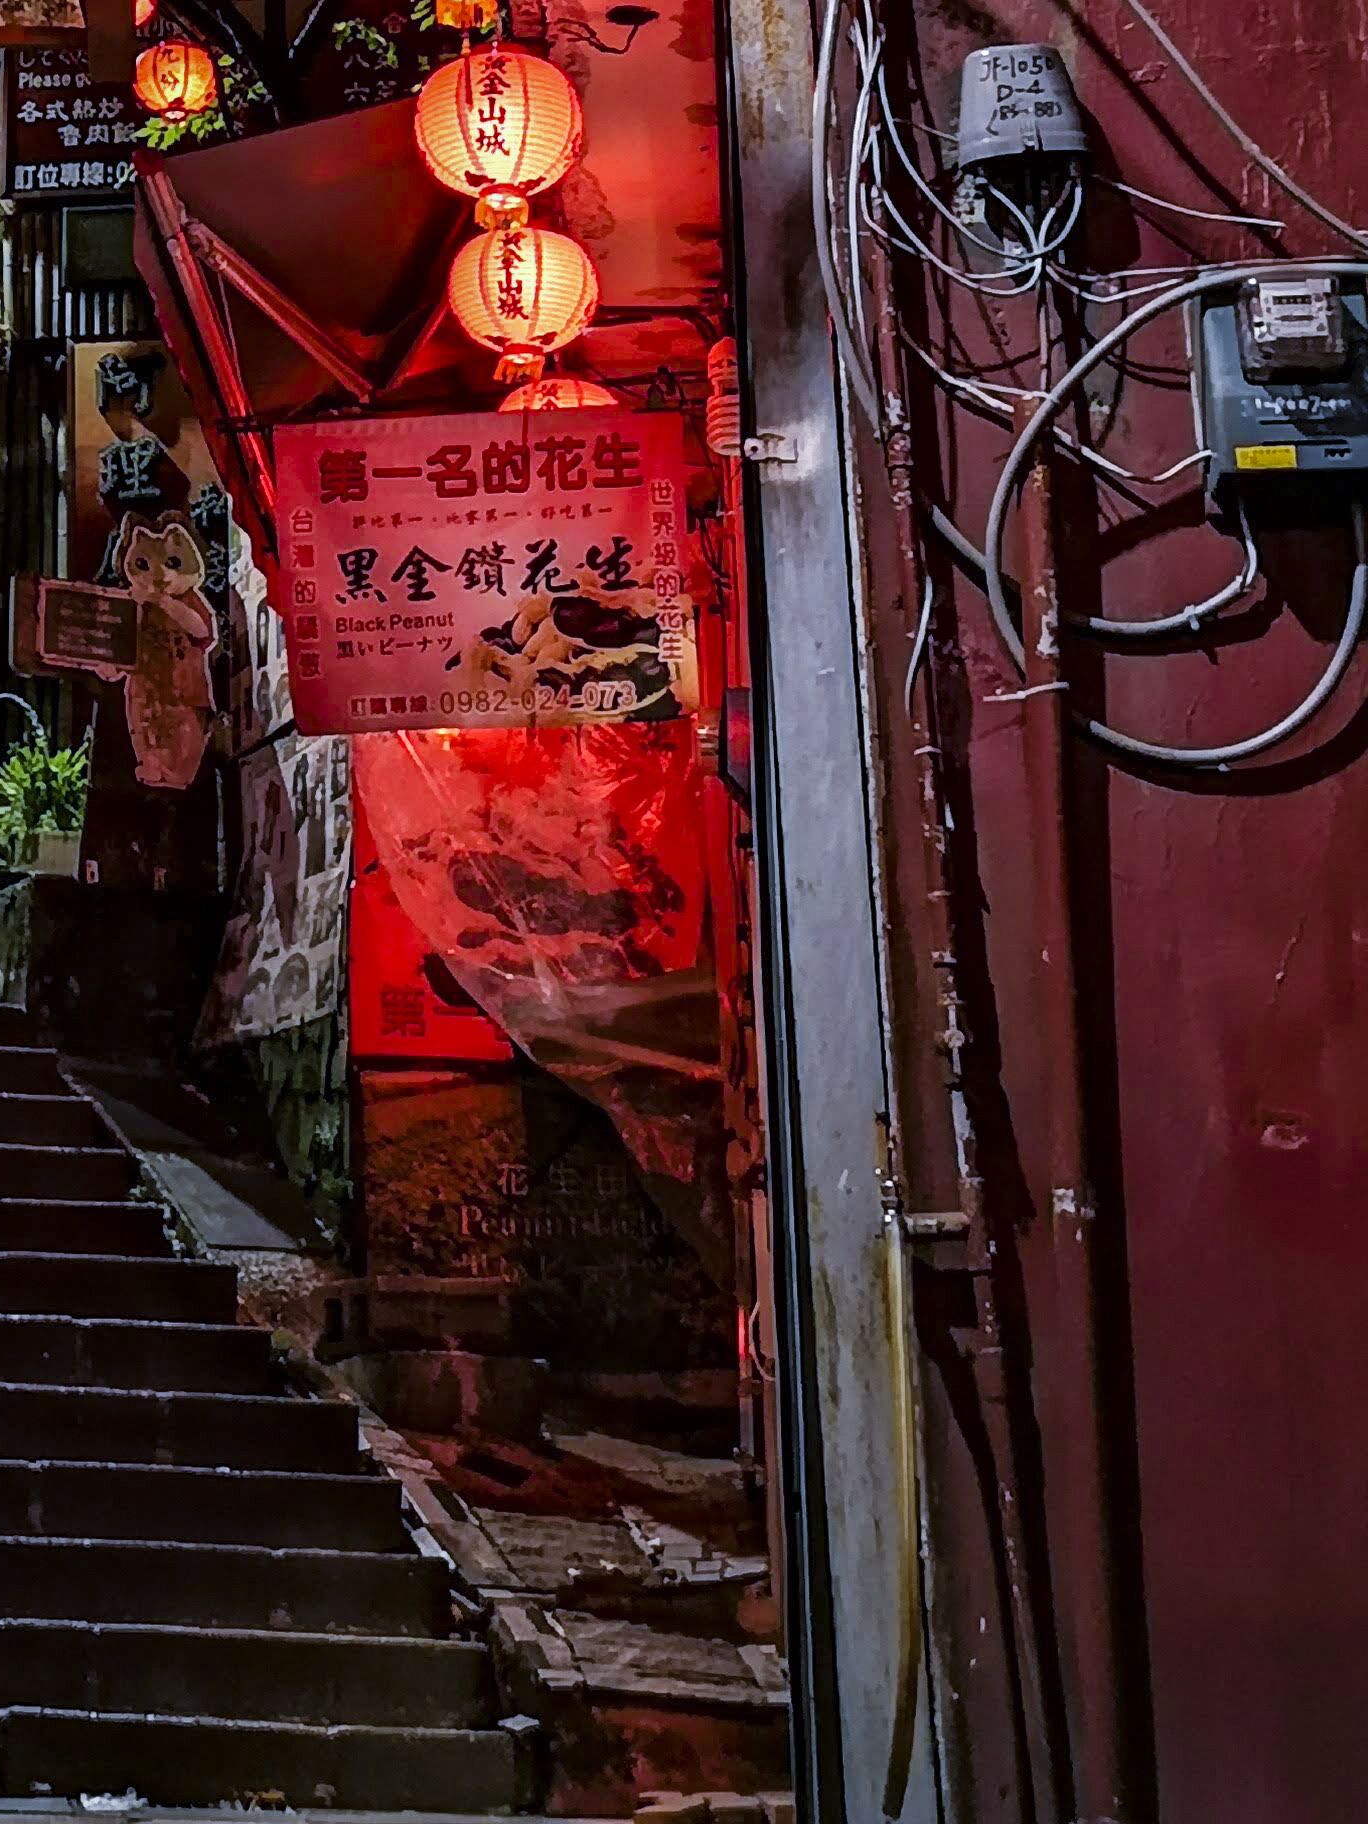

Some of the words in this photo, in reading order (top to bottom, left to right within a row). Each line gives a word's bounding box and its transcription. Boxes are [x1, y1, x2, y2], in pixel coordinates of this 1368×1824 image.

[18, 72, 72, 89] Please
[979, 54, 1056, 82] JF-1050
[318, 431, 645, 504] 第一名的花生
[335, 537, 642, 605] 黑金鑽花生
[335, 616, 387, 634] Black
[389, 611, 455, 631] Peanut
